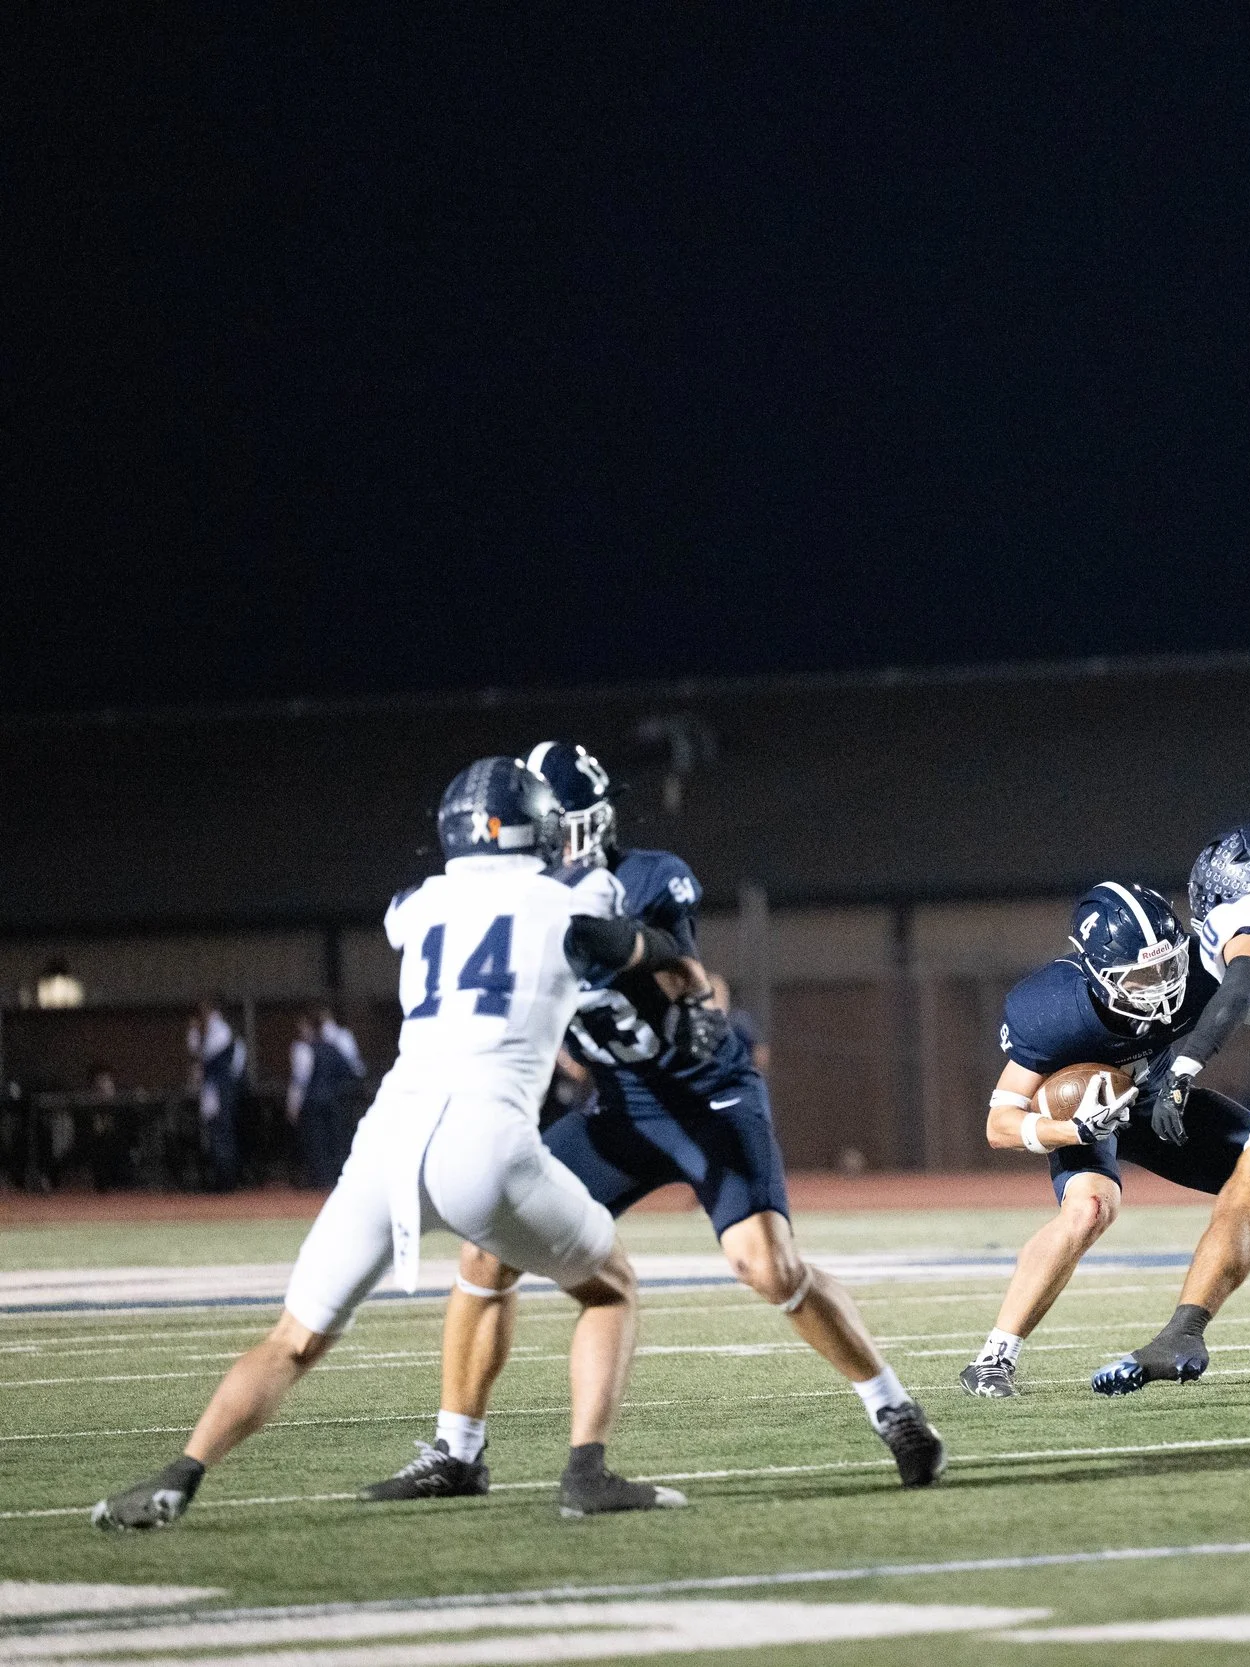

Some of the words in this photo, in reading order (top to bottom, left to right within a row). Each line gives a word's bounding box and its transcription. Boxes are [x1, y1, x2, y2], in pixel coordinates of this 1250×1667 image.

[1079, 911, 1101, 941] 4
[1141, 943, 1171, 960] Riddell
[404, 913, 517, 1021] 14
